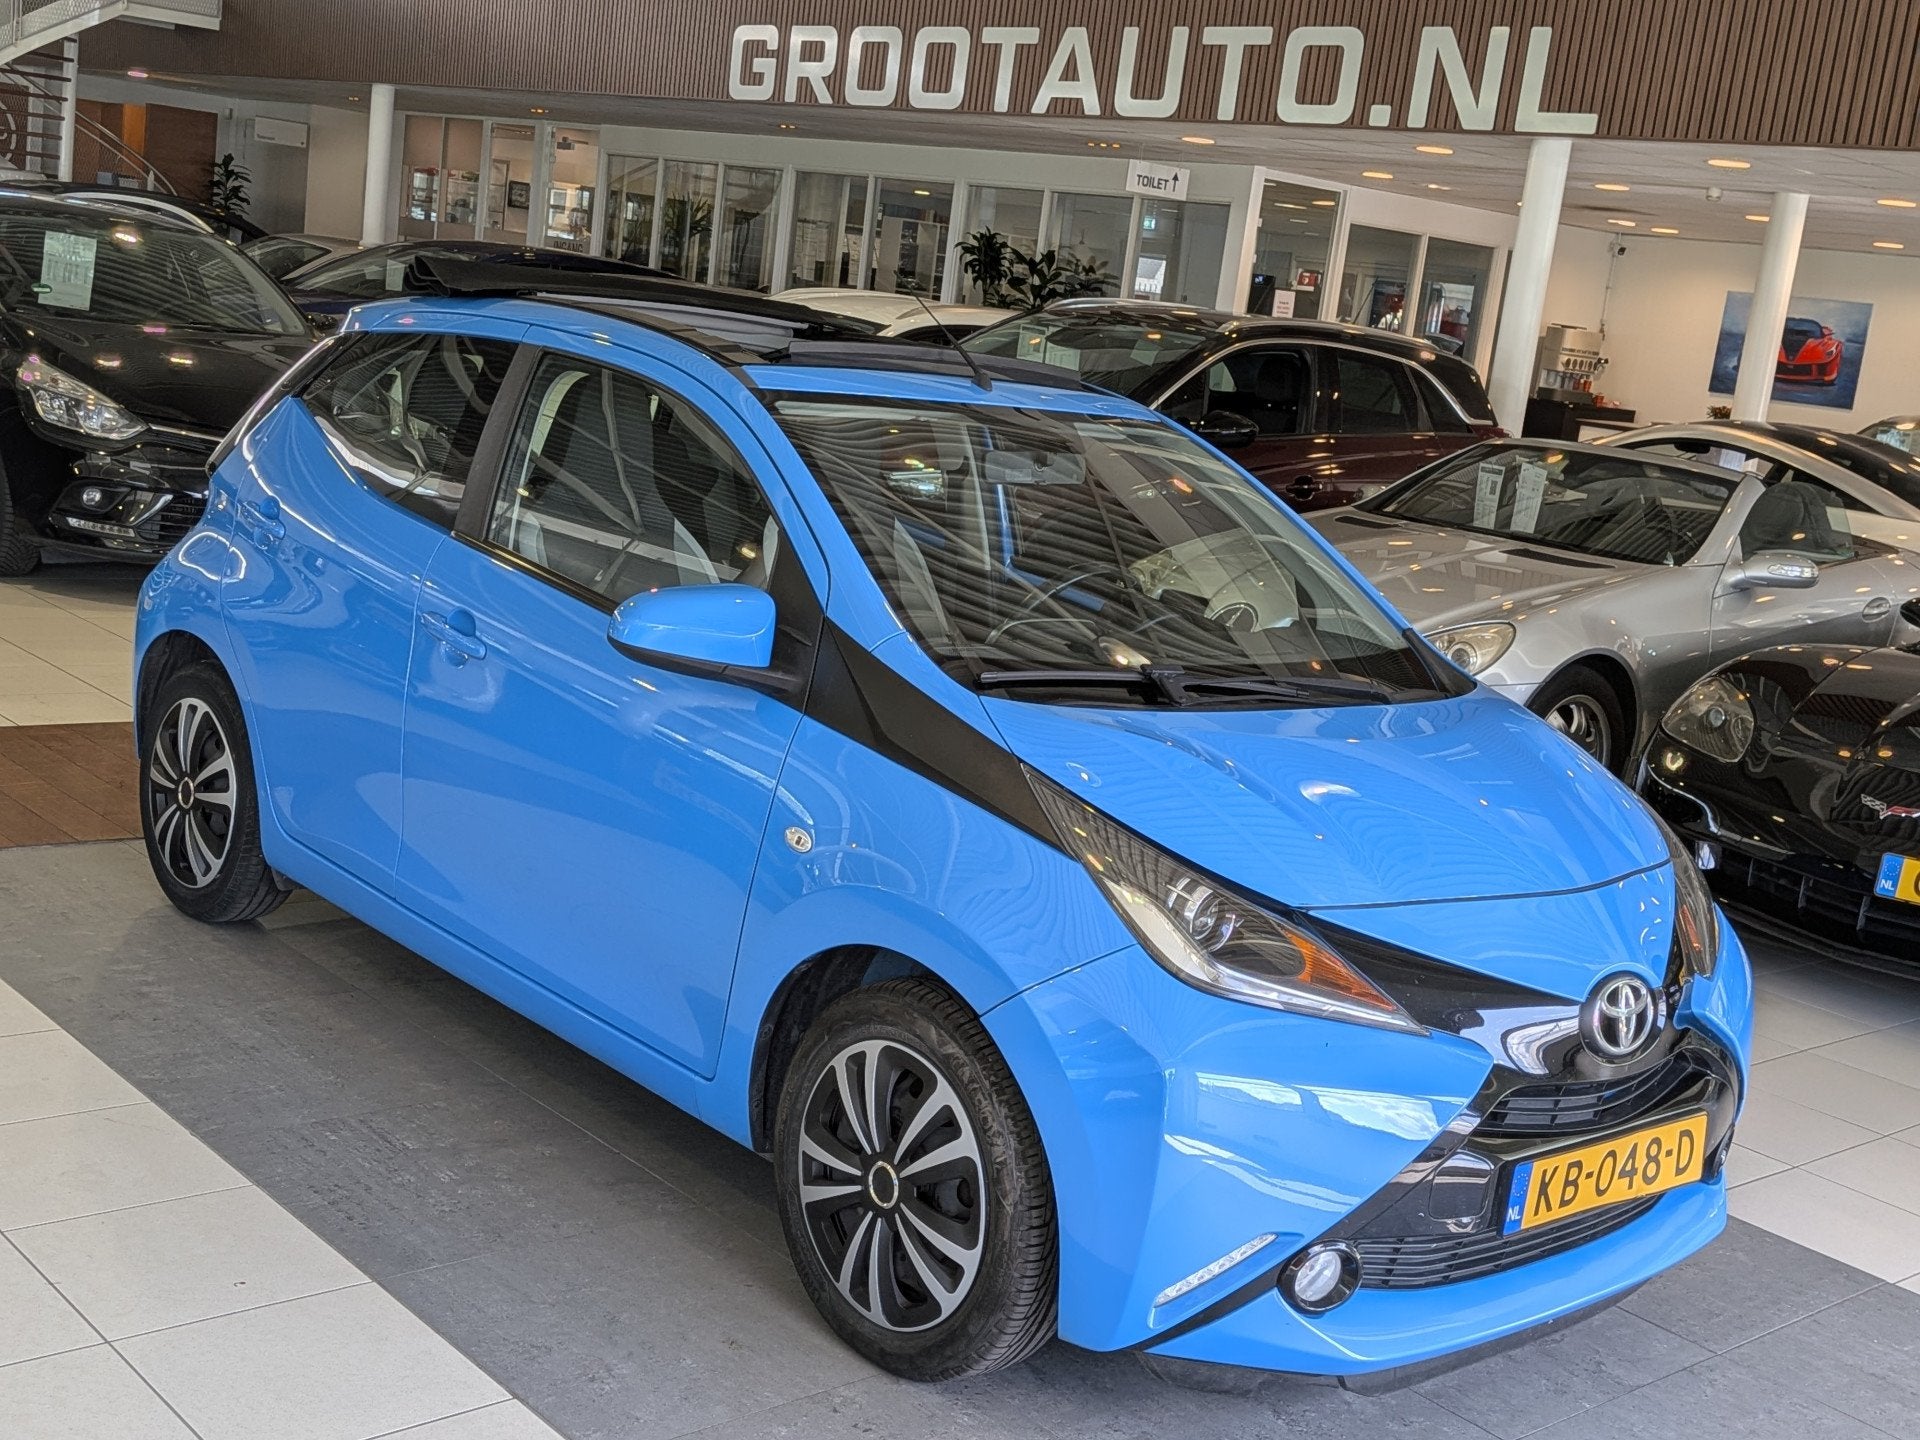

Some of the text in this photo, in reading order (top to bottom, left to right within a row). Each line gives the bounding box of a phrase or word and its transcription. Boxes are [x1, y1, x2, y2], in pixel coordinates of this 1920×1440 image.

[729, 25, 1599, 134] GROOTAUTO.NL
[1136, 173, 1170, 191] TOILET
[1880, 878, 1895, 891] NL
[1533, 1128, 1695, 1217] KB-048-D
[1506, 1205, 1521, 1222] NL
